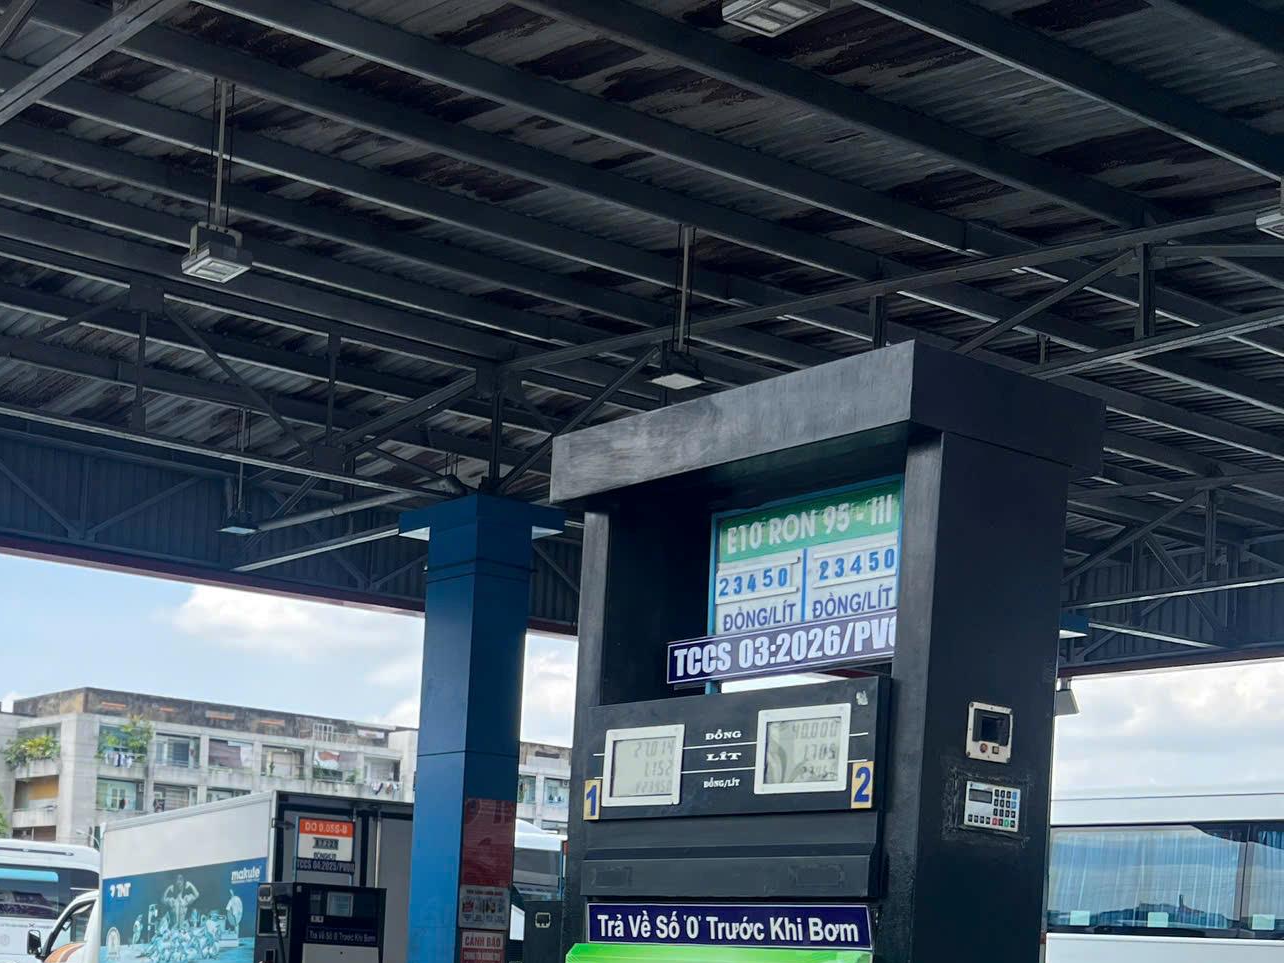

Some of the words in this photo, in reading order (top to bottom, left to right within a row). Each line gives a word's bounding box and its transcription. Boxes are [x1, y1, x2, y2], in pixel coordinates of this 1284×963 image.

[726, 523, 764, 554] E10
[769, 509, 816, 545] RON
[823, 502, 850, 534] 95
[819, 548, 895, 581] 23450
[718, 567, 789, 597] 23450
[673, 641, 732, 677] TCCS
[584, 784, 598, 817] 1
[855, 766, 872, 804] 2
[597, 913, 624, 938] Trả
[628, 910, 651, 938] Về
[655, 910, 681, 939] Số
[706, 915, 765, 940] Trước
[769, 917, 804, 941] Khi
[808, 917, 860, 942] Bơm
